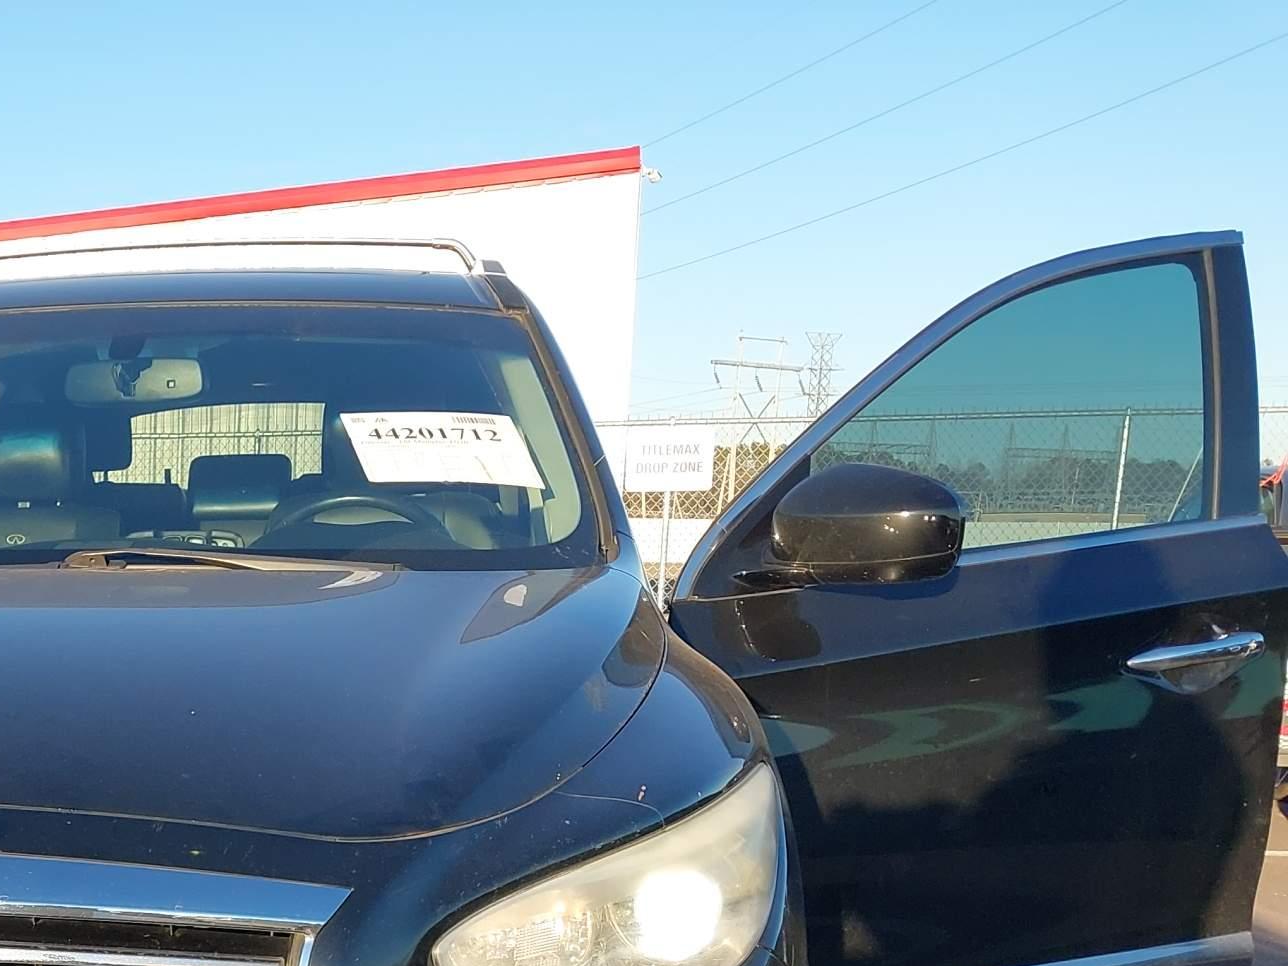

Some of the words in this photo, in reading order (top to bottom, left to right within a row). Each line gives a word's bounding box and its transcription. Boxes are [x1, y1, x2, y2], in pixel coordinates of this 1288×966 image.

[368, 427, 502, 442] 44201712
[642, 444, 700, 456] TITLEMAX
[636, 463, 668, 473] DROP
[672, 462, 704, 473] ZONE
